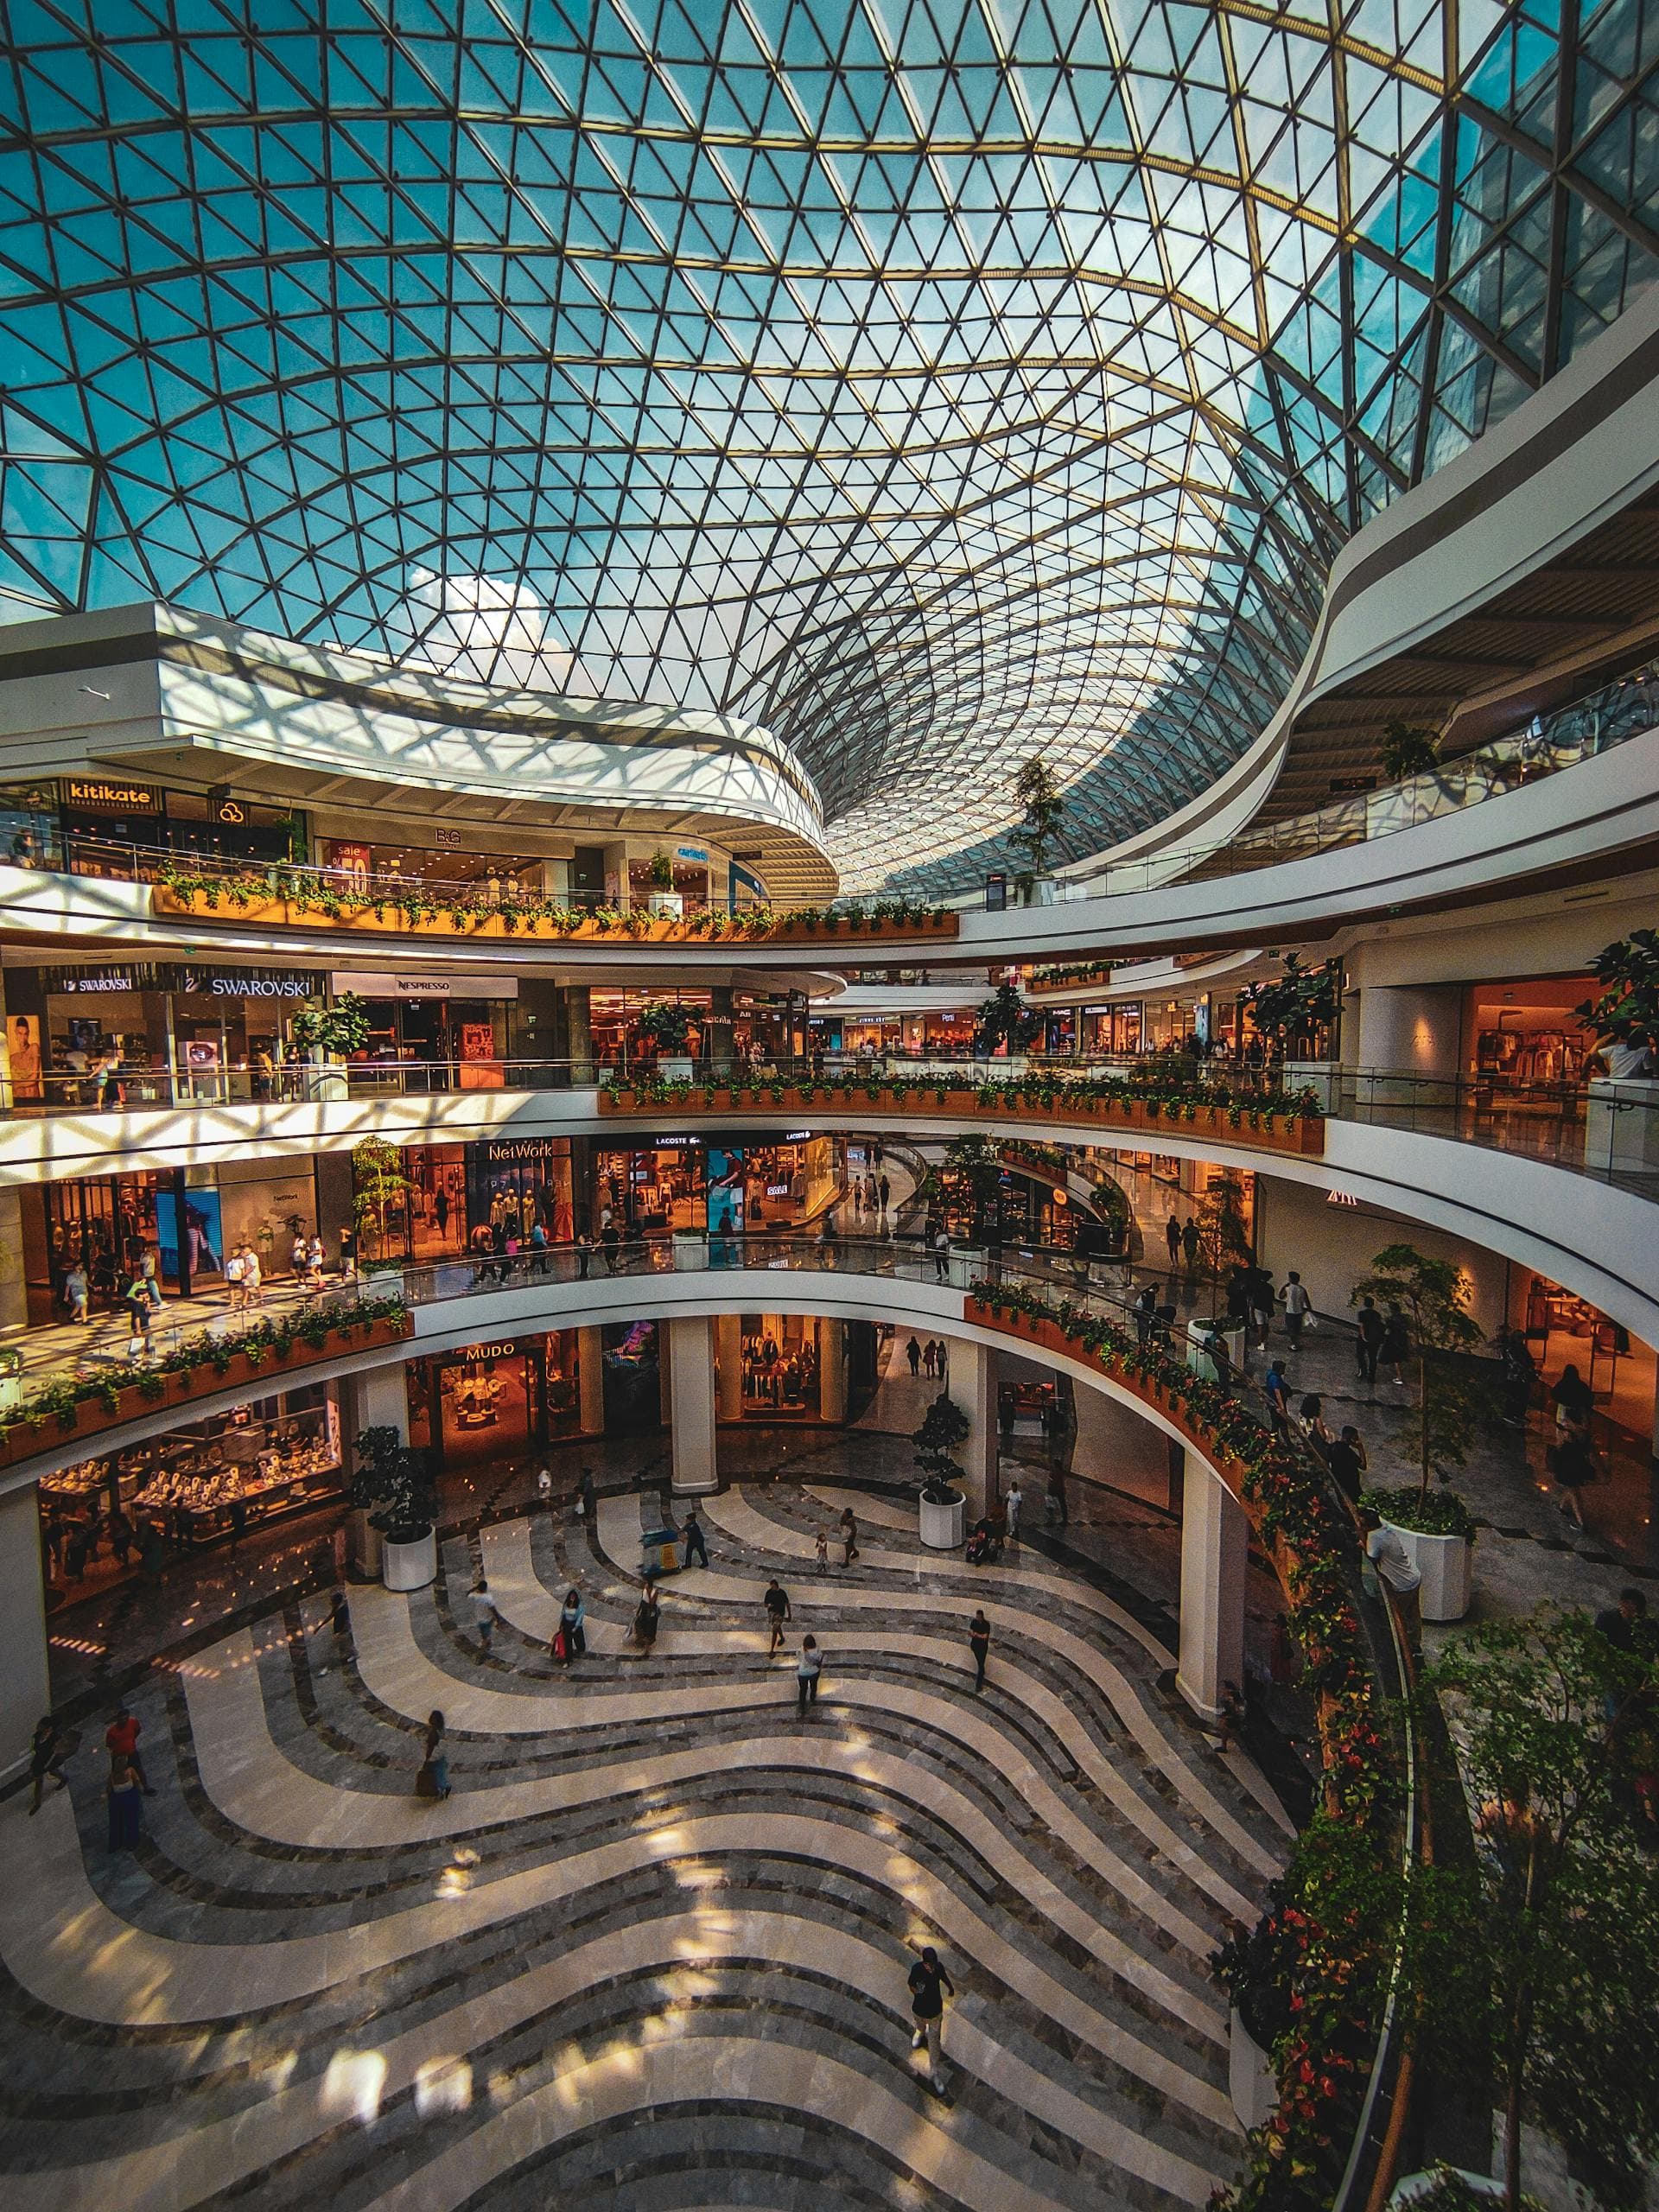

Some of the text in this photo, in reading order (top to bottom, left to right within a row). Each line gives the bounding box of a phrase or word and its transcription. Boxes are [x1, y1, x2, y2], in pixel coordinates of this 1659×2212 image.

[71, 783, 151, 804] kitikate
[435, 828, 461, 844] B&G
[338, 845, 360, 856] sale
[79, 978, 132, 992] SWAROVSKI
[213, 978, 310, 997] SWAROVSKI
[397, 979, 450, 992] NESPRESSO
[489, 1142, 553, 1160] NetWork
[767, 1185, 788, 1196] SALE
[467, 1344, 515, 1361] MUDO
